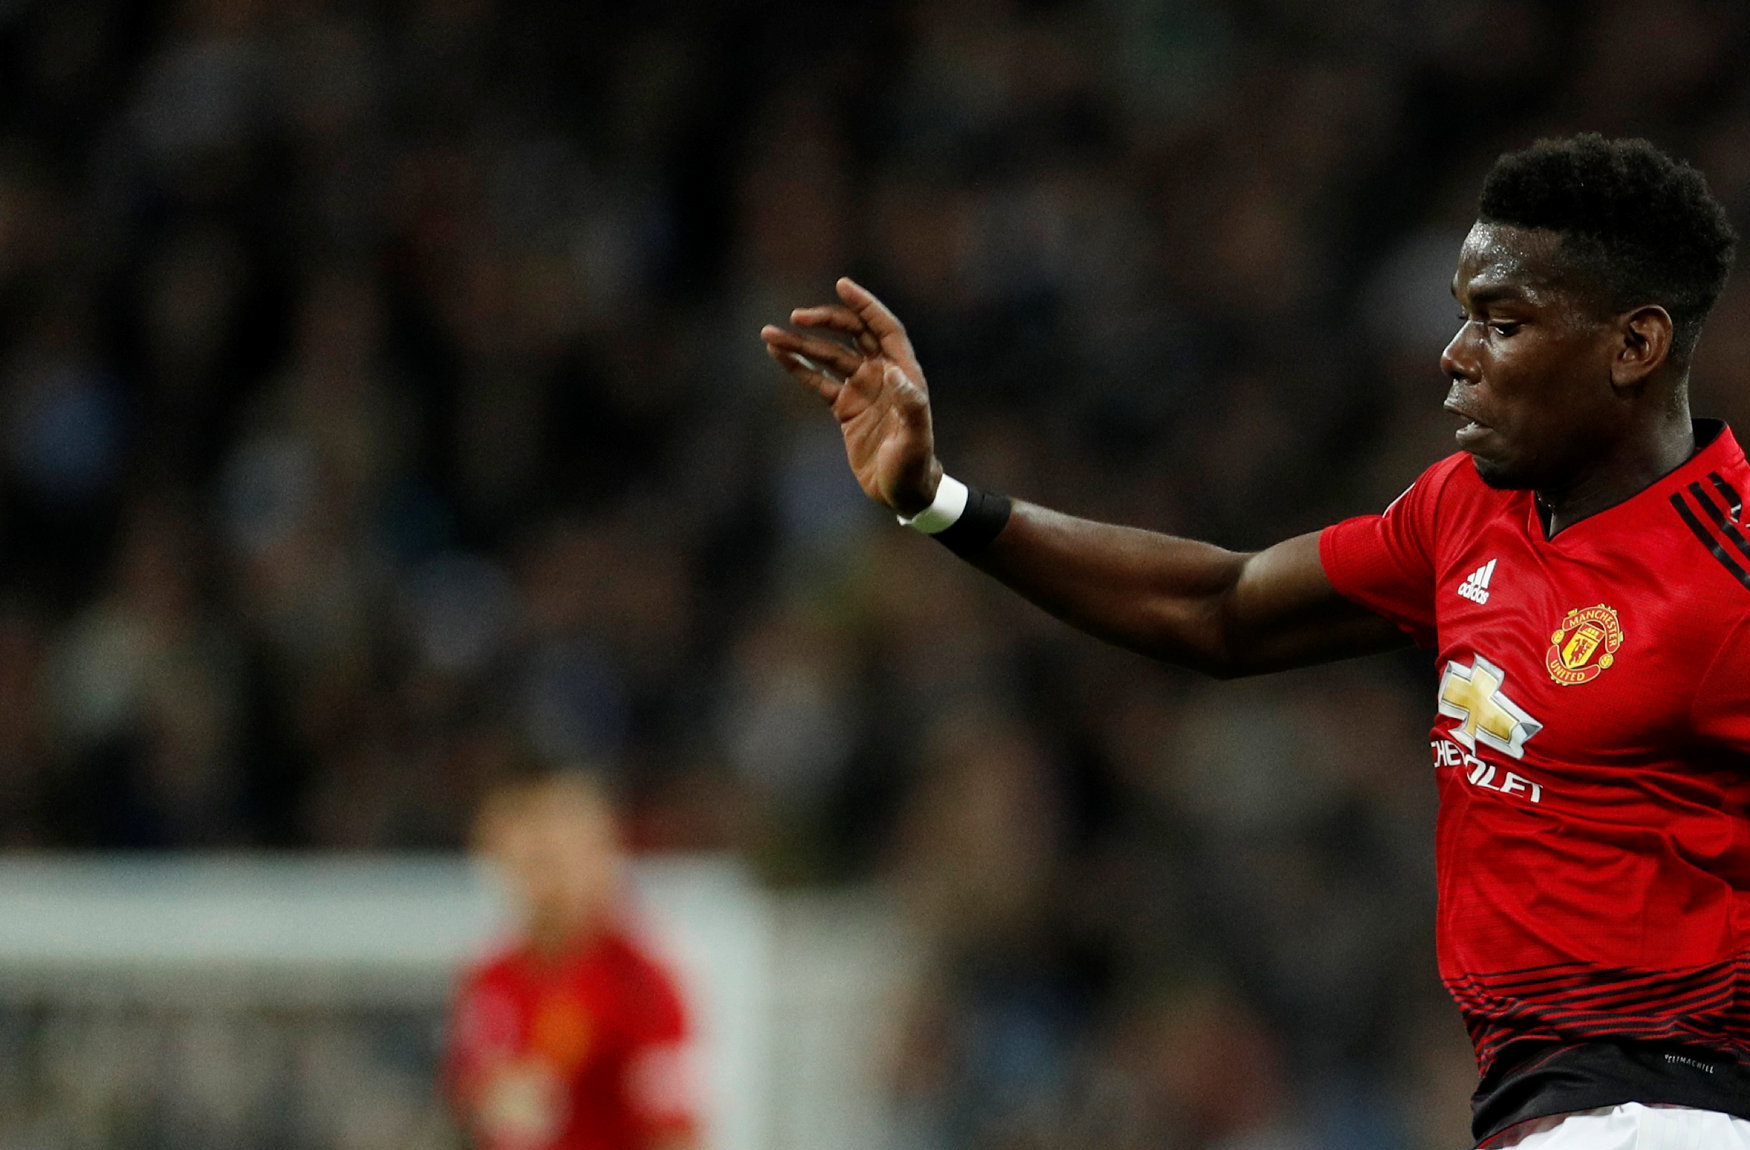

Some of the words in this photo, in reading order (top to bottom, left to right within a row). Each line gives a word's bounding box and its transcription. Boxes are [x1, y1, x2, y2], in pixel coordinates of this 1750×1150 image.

[1457, 582, 1490, 605] adidas
[1569, 609, 1618, 648] MANCHESTER
[1550, 659, 1586, 681] UNITED
